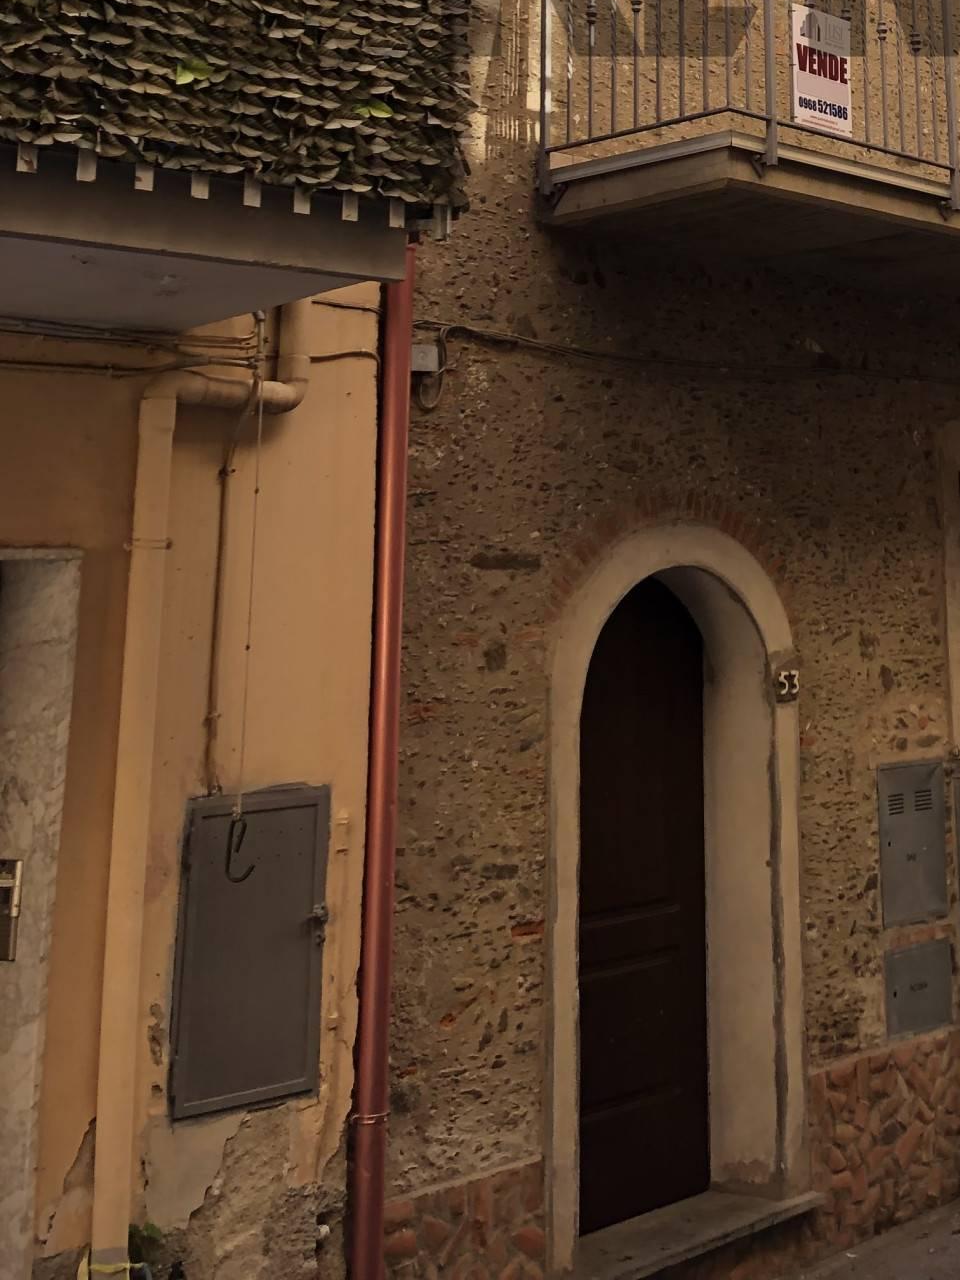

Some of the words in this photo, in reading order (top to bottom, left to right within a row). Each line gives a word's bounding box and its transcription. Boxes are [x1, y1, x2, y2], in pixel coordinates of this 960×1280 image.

[796, 43, 848, 84] VENDE
[798, 96, 817, 112] 0968
[817, 99, 848, 120] 521586
[779, 670, 799, 695] 53
